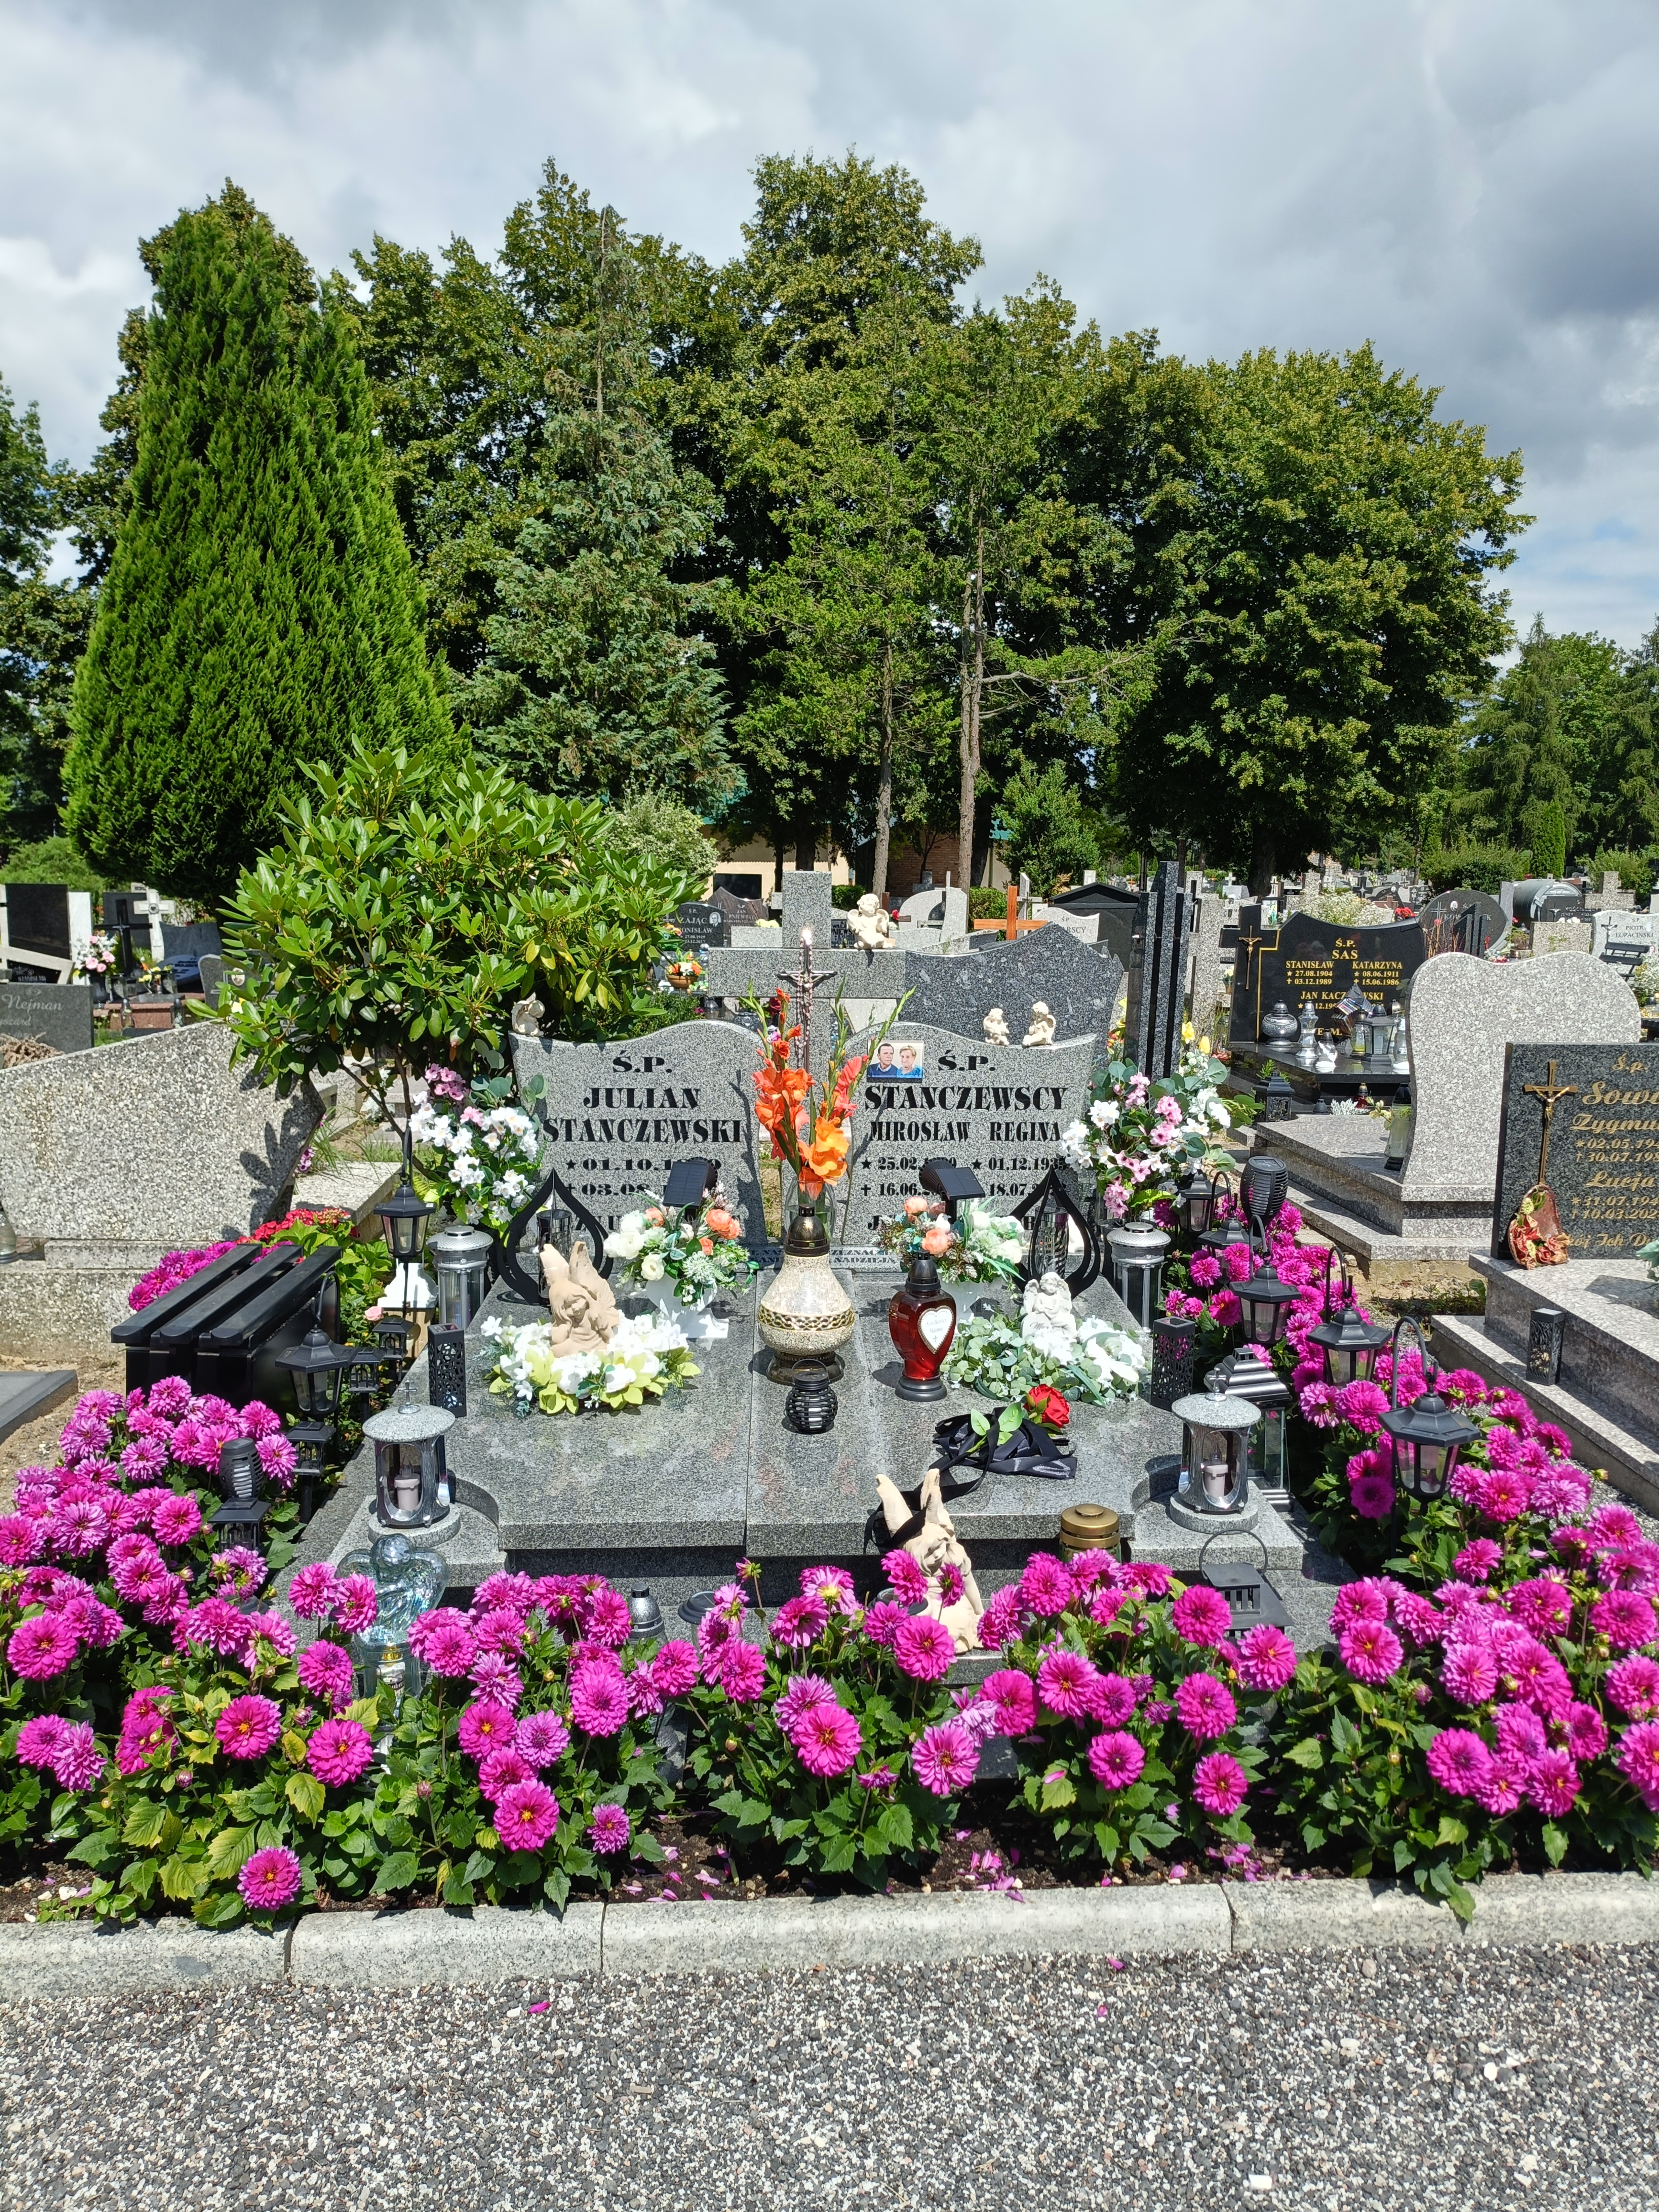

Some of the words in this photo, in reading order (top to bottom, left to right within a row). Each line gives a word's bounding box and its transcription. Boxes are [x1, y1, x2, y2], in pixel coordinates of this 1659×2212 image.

[680, 917, 707, 925] ZAJĄC
[1335, 938, 1356, 947] Ś.P.
[1332, 950, 1358, 960] SAS
[1285, 961, 1335, 969] STANISŁAW
[1352, 961, 1403, 969] KATARZYNA
[1300, 991, 1318, 999] JAN
[1, 994, 63, 1013] Nejman
[612, 1050, 673, 1073] Ś.P.
[938, 1050, 996, 1071] Ś.P.
[1612, 1052, 1648, 1073] Ś.p.
[583, 1087, 701, 1109] JULIAN
[864, 1085, 1069, 1111] STANCZEWSCY
[543, 1117, 741, 1144] STANCZEWSKI
[869, 1121, 971, 1142] MIROSŁAW
[990, 1121, 1061, 1142] REGINA
[1569, 1113, 1659, 1134] Zygmu
[1587, 1138, 1659, 1149] 02.05.194
[1586, 1151, 1659, 1162] 30.07.198
[1586, 1170, 1656, 1192] Łucja
[1582, 1195, 1659, 1206] 31.07.194
[1582, 1208, 1659, 1219] 10.03.202
[1595, 1233, 1625, 1247] Ich
